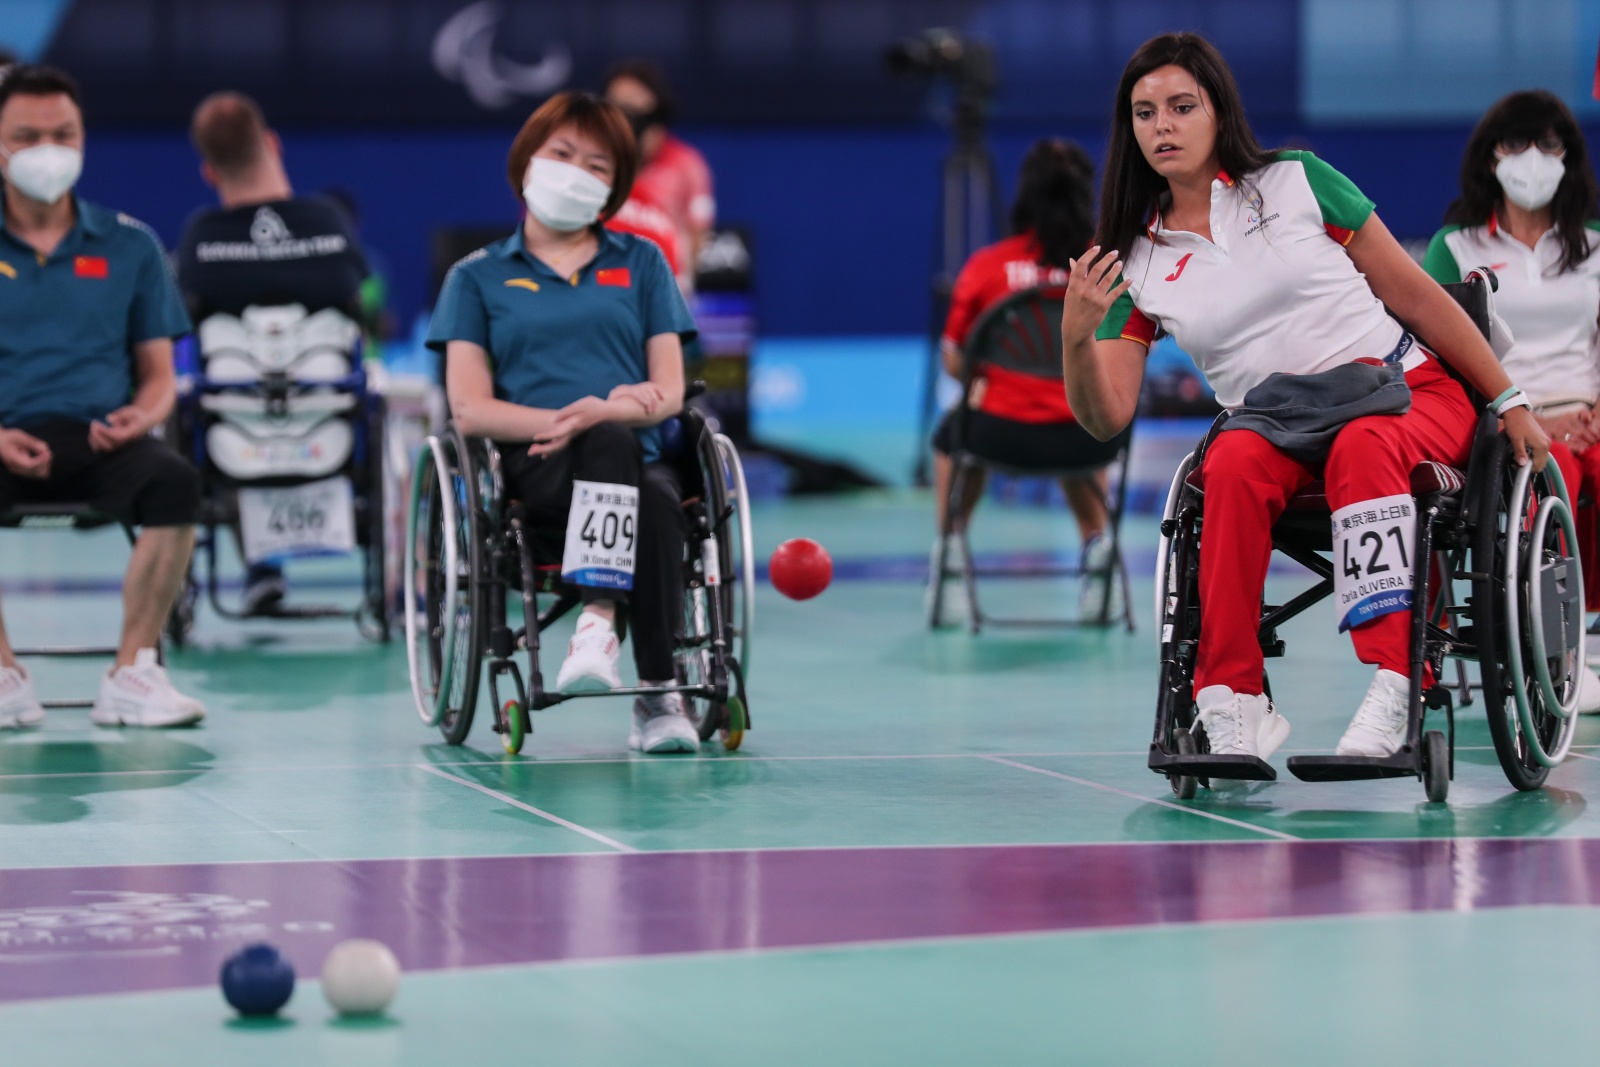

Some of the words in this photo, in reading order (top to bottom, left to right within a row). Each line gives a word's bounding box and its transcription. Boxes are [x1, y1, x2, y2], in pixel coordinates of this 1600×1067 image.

[581, 510, 633, 551] 409
[1341, 504, 1411, 532] 東京海上日動
[615, 557, 632, 567] CHN
[1344, 526, 1409, 580] 421
[1341, 590, 1358, 604] Carla
[1358, 576, 1404, 596] OLIVEIRA
[1358, 600, 1379, 615] TOKYO
[1379, 597, 1399, 609] 2020
